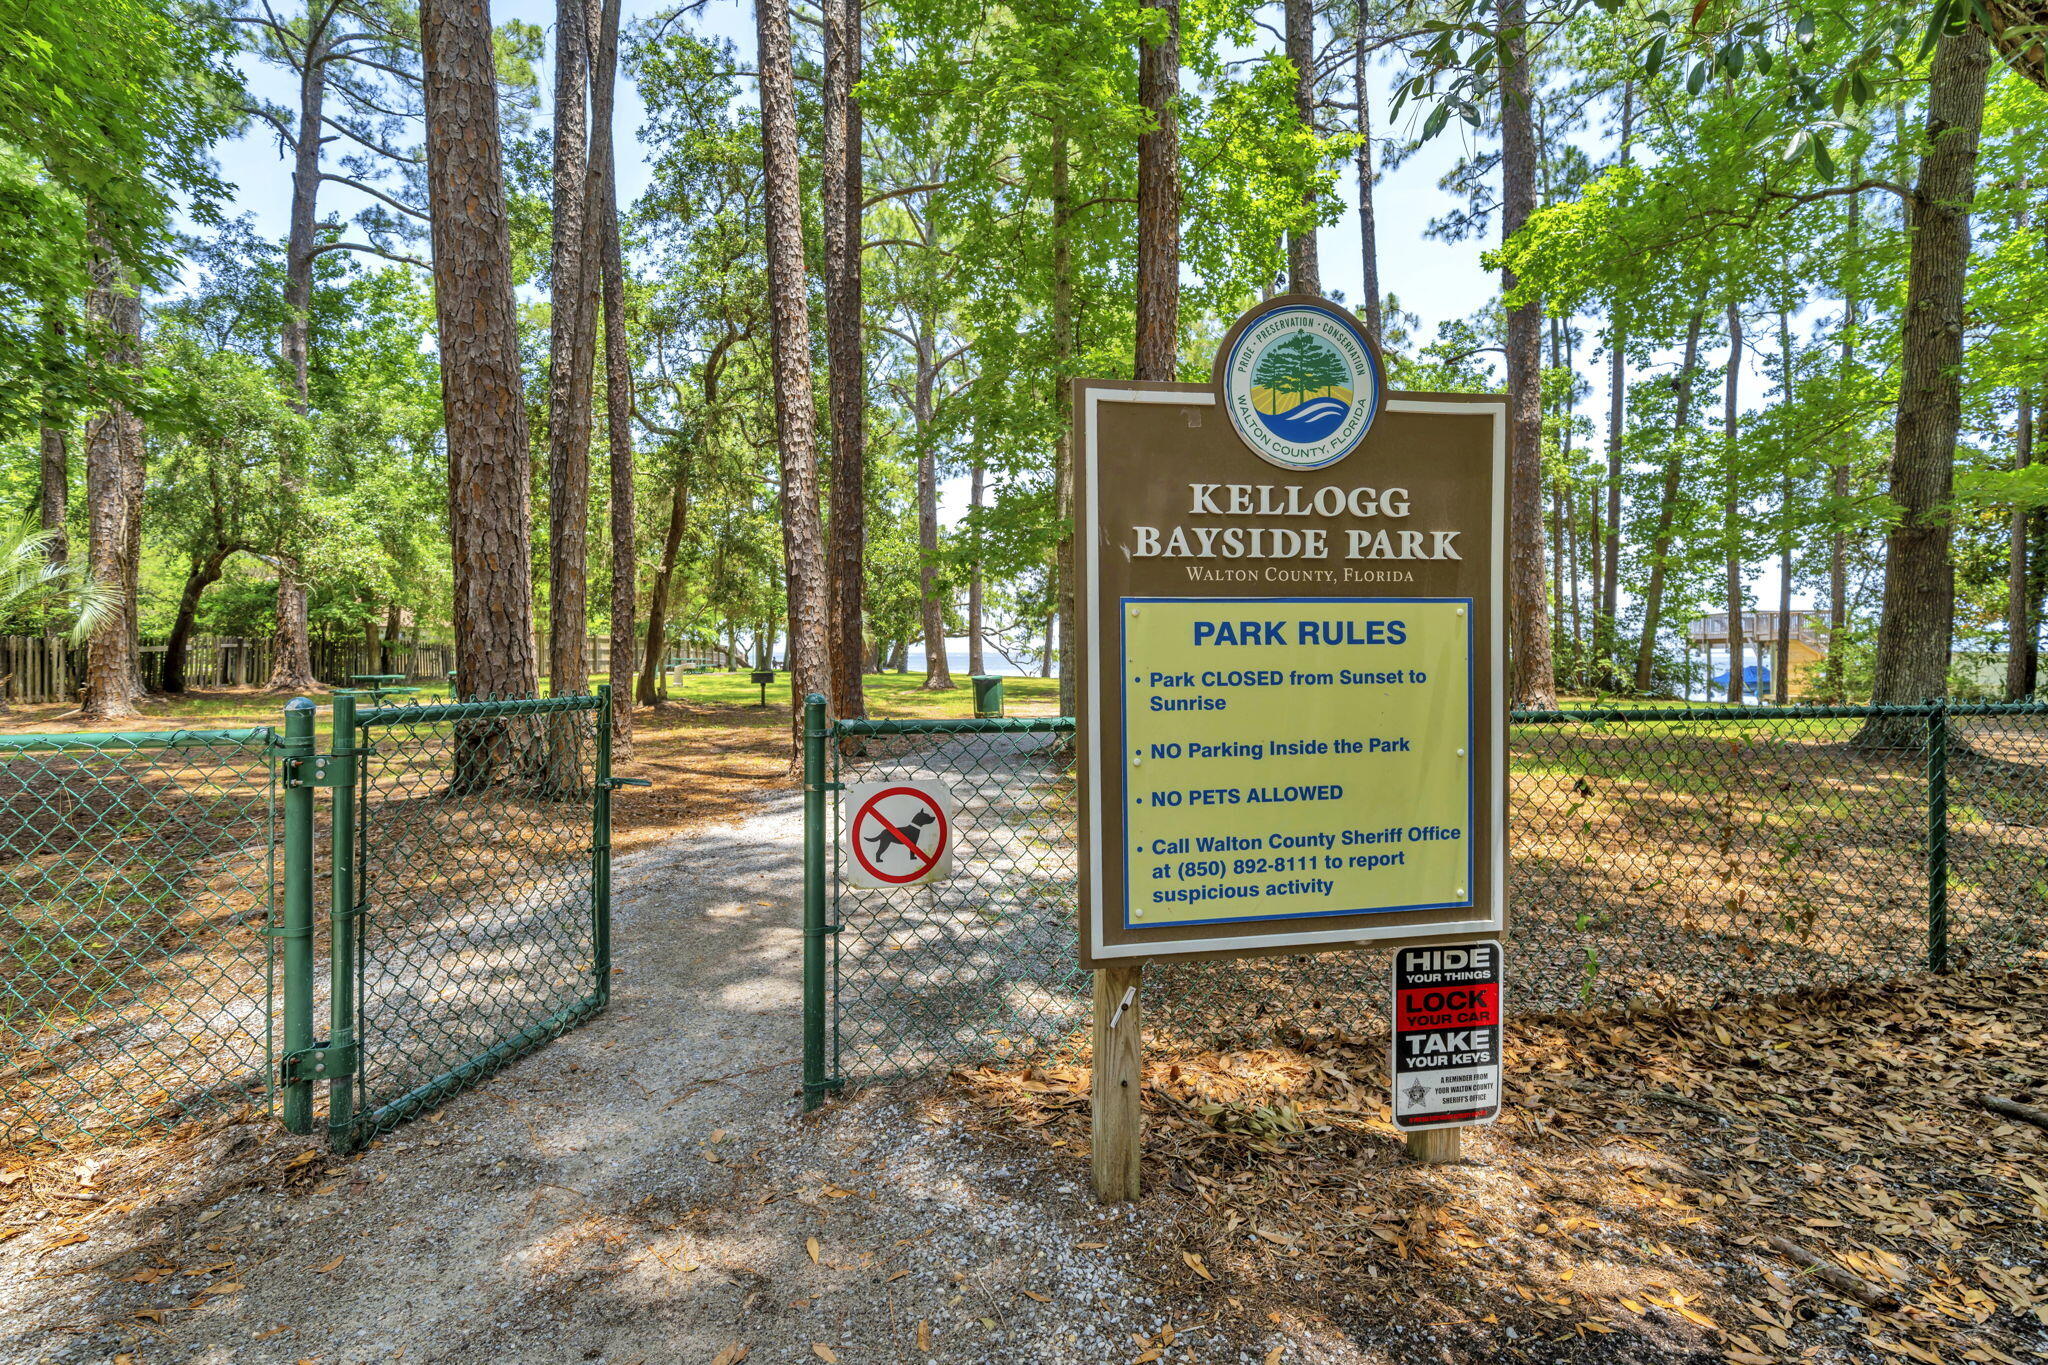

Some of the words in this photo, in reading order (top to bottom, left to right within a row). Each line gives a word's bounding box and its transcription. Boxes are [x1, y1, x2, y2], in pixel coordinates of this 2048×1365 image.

[1238, 346, 1255, 373] PRIDE
[1256, 317, 1314, 343] PRESERVATION
[1323, 323, 1366, 376] CONSERVATION
[1238, 395, 1271, 445] WALTON
[1272, 442, 1329, 457] COUNTY,
[1331, 398, 1366, 449] FLORIDA
[1189, 483, 1410, 517] KELLOGG
[1132, 526, 1329, 559] BAYSIDE
[1344, 529, 1463, 561] PARK
[1186, 566, 1258, 581] WALTON
[1344, 568, 1413, 582] FLORIDA
[1193, 621, 1288, 646] PARK
[1299, 620, 1407, 645] RULES
[1150, 671, 1195, 688] Park
[1201, 670, 1283, 686] CLOSED
[1290, 671, 1333, 685] from
[1340, 669, 1403, 685] Sunset
[1409, 670, 1426, 684] to
[1150, 696, 1226, 712] Sunrise
[1151, 743, 1182, 759] NO
[1189, 742, 1263, 761] Parking
[1270, 739, 1328, 756] Inside
[1334, 739, 1363, 754] the
[1369, 738, 1410, 753] Park
[1151, 791, 1182, 807] NO
[1189, 789, 1241, 805] PETS
[1246, 785, 1343, 802] ALLOWED
[1152, 840, 1190, 855] Call
[1196, 836, 1262, 853] Walton
[1269, 833, 1335, 851] County
[1341, 829, 1402, 846] Sheriff
[1408, 825, 1461, 842] Office
[1152, 864, 1171, 879] at
[1178, 861, 1227, 881] (850)
[1233, 856, 1318, 875] 892-8111
[1324, 855, 1343, 870] to
[1349, 852, 1405, 871] report
[1153, 884, 1259, 905] suspicious
[1265, 879, 1334, 897] activity
[1406, 948, 1490, 972] HIDE
[1406, 974, 1441, 984] YOUR
[1445, 970, 1491, 981] THINGS
[1406, 989, 1488, 1013] LOCK
[1407, 1015, 1451, 1027] YOUR
[1457, 1011, 1490, 1023] CAR
[1406, 1029, 1489, 1054] TAKE
[1406, 1055, 1448, 1068] YOUR
[1452, 1051, 1490, 1064] KEYS
[1445, 1075, 1472, 1083] REMINDER
[1473, 1083, 1493, 1092] COUNTY
[1442, 1096, 1468, 1104] SHERIFF'S
[1469, 1094, 1486, 1102] OFFICE
